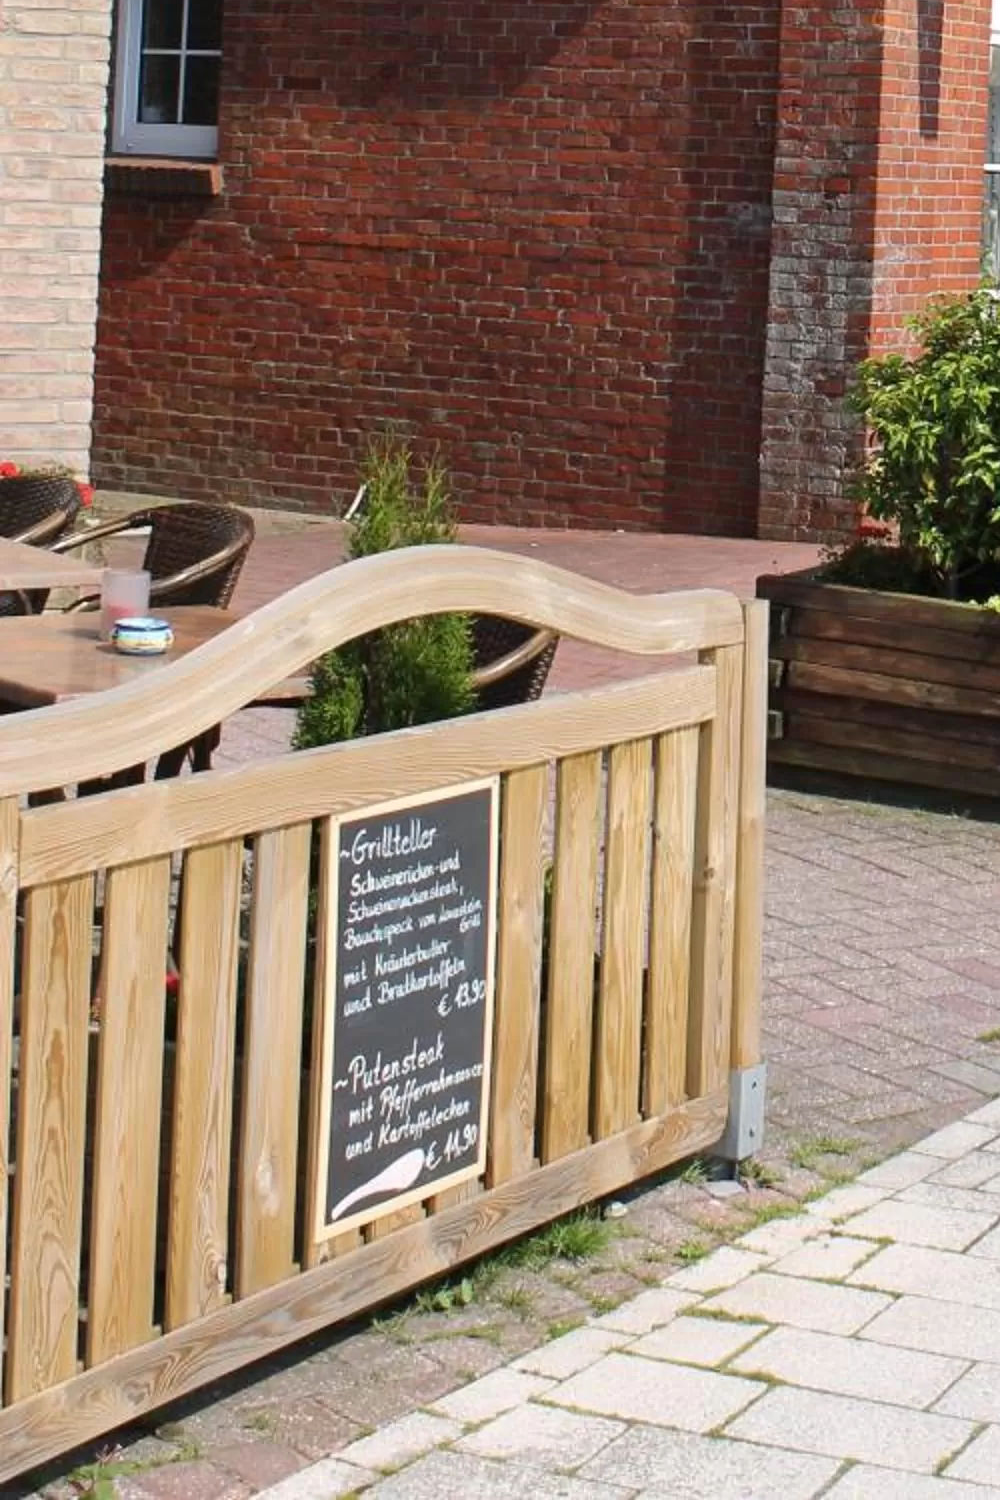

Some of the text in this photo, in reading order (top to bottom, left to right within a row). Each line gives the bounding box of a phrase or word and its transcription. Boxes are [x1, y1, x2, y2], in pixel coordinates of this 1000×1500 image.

[343, 961, 368, 988] mit
[343, 986, 373, 1017] und
[348, 1031, 446, 1095] Putensteak
[348, 1096, 375, 1127] mit
[345, 1131, 373, 1162] und
